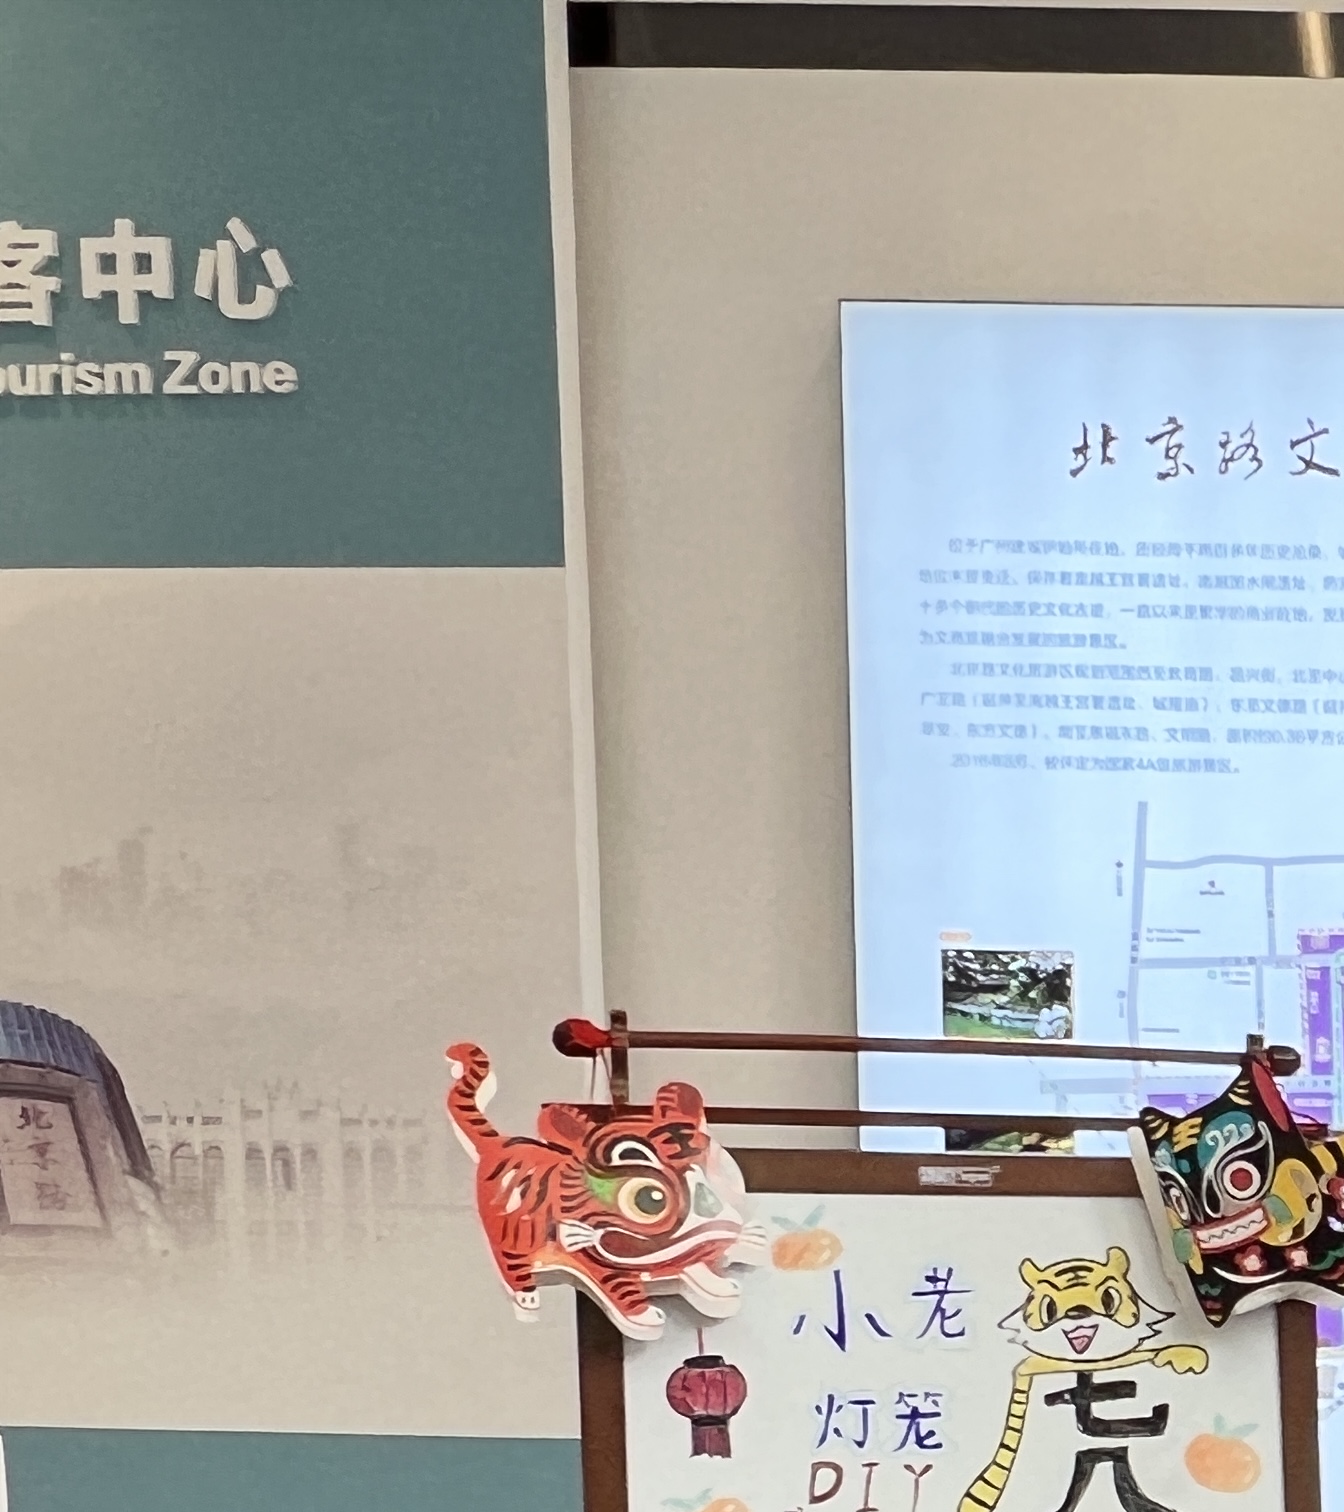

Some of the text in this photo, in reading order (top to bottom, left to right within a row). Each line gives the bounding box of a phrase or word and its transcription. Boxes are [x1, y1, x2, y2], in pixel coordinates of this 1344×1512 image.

[0, 350, 299, 396] urism Zone
[793, 1267, 974, 1352] 小老
[814, 1391, 943, 1452] 灯笼
